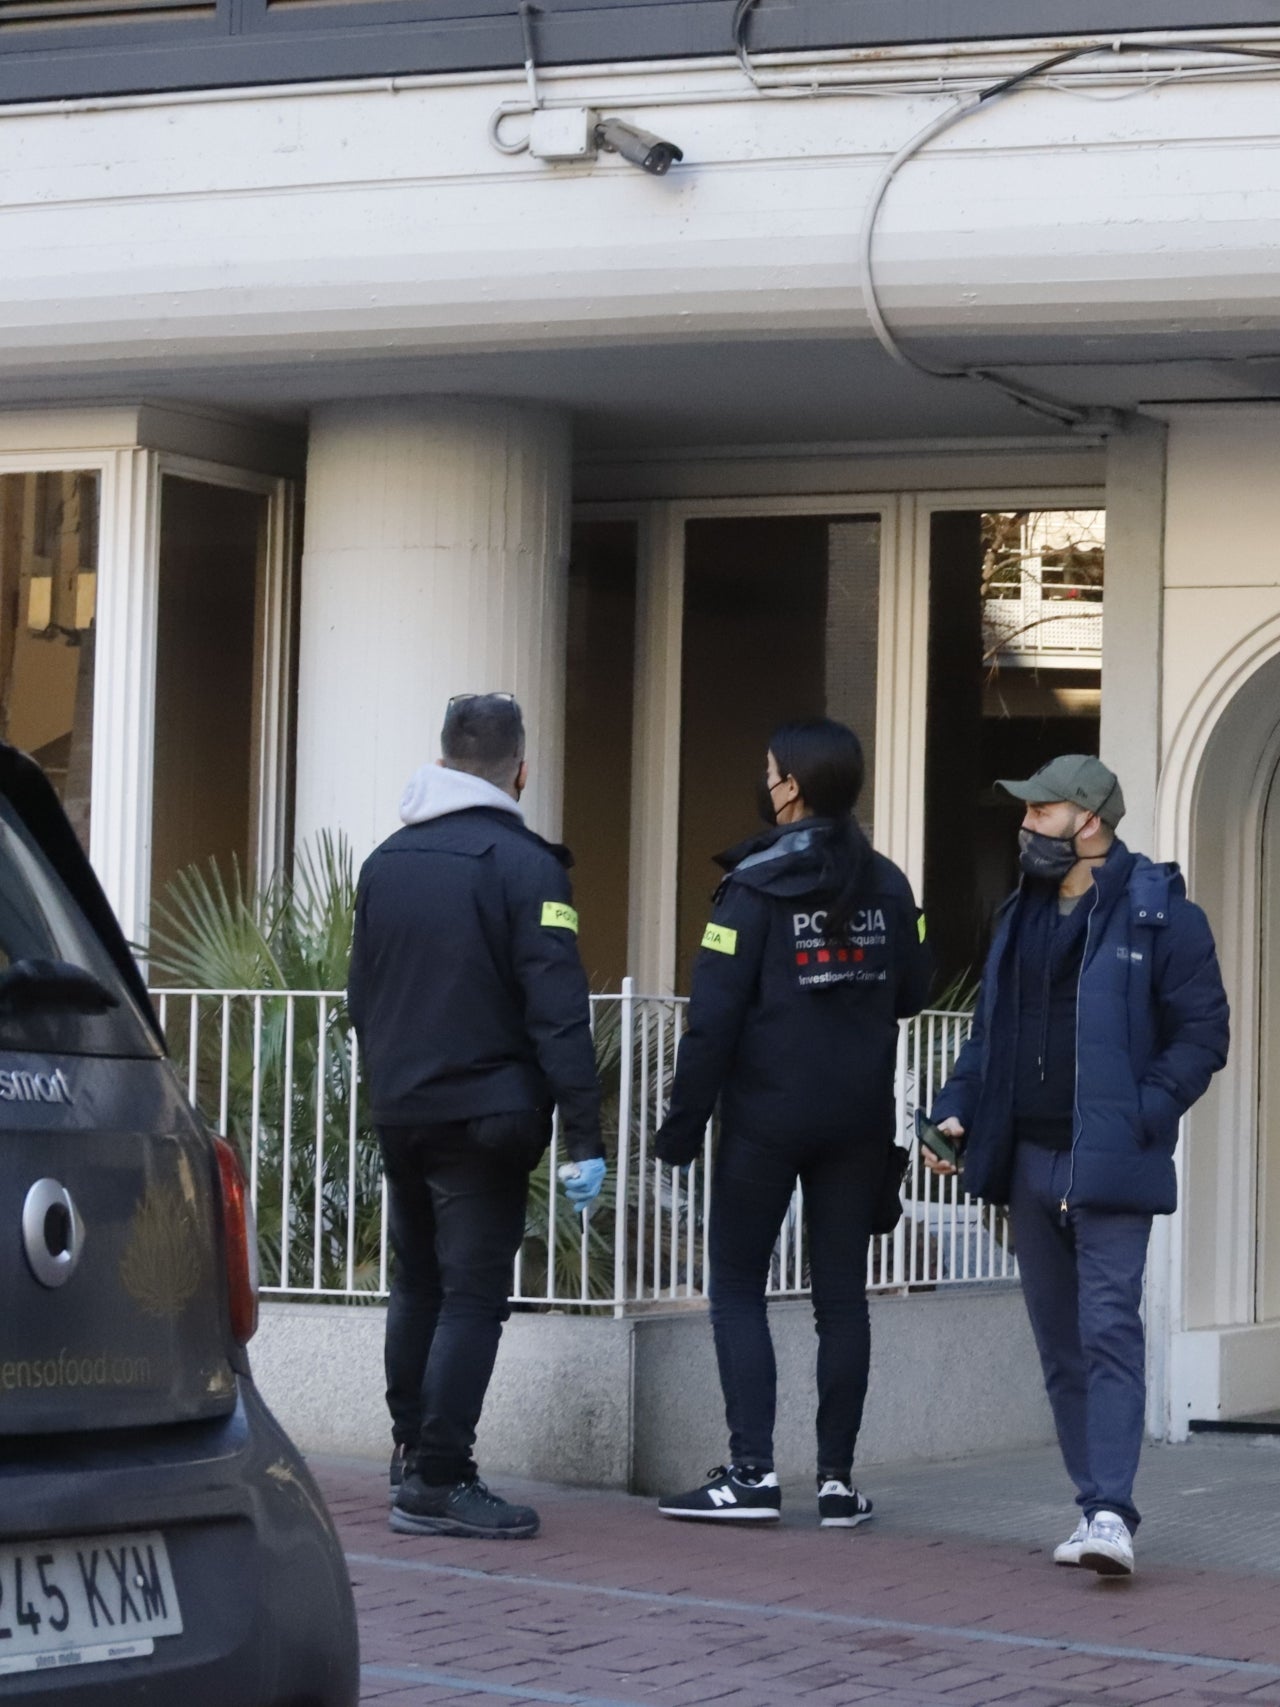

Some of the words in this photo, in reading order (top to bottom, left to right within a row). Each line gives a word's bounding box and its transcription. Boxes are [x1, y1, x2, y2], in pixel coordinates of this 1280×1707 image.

[793, 909, 886, 936] POCIA
[0, 1068, 75, 1105] smart
[77, 1544, 168, 1629] KXM
